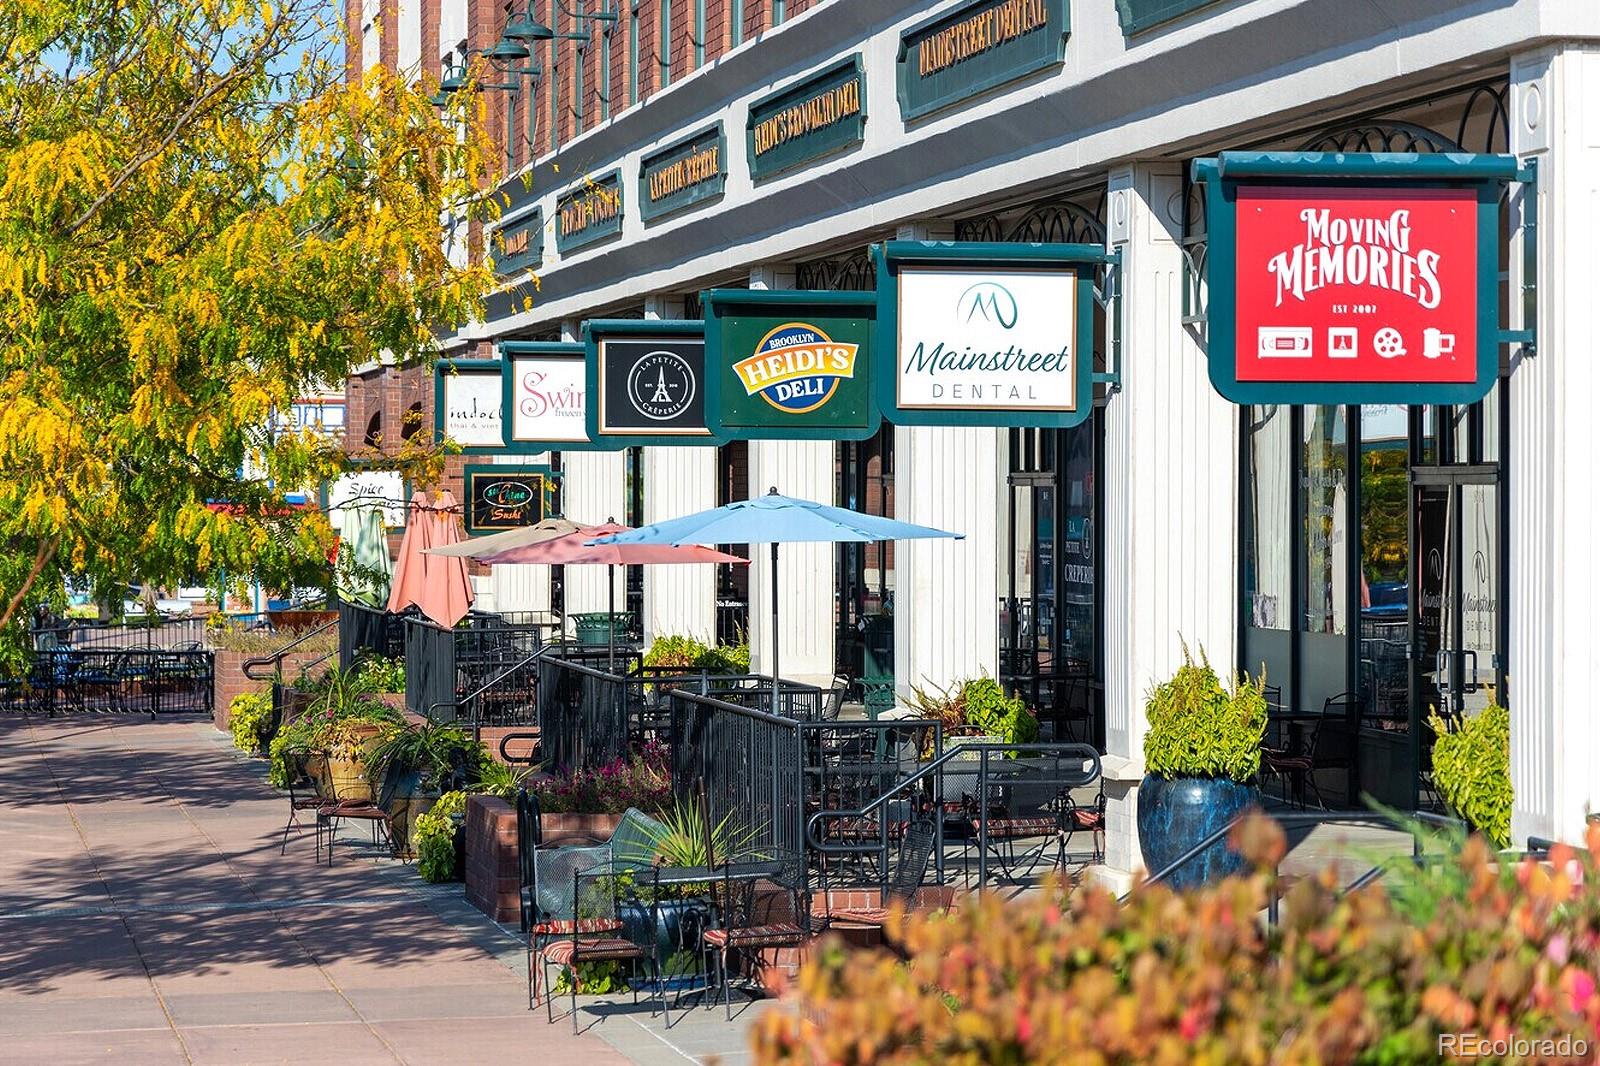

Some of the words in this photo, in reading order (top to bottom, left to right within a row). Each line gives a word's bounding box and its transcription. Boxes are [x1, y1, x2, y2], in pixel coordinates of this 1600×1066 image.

[919, 8, 993, 76] MAINSTREET
[1300, 208, 1411, 253] MOVING
[1267, 244, 1441, 309] MEMORIES
[1332, 304, 1348, 314] EST
[770, 333, 815, 348] BROOKLYN
[640, 362, 651, 371] LA
[653, 357, 683, 371] PETITE
[744, 346, 850, 386] HEIDI'S
[905, 341, 1069, 376] Mainstreet
[775, 378, 825, 402] DELI
[932, 383, 1037, 400] DENTAL
[348, 482, 384, 498] Spice
[490, 509, 522, 521] Sushi
